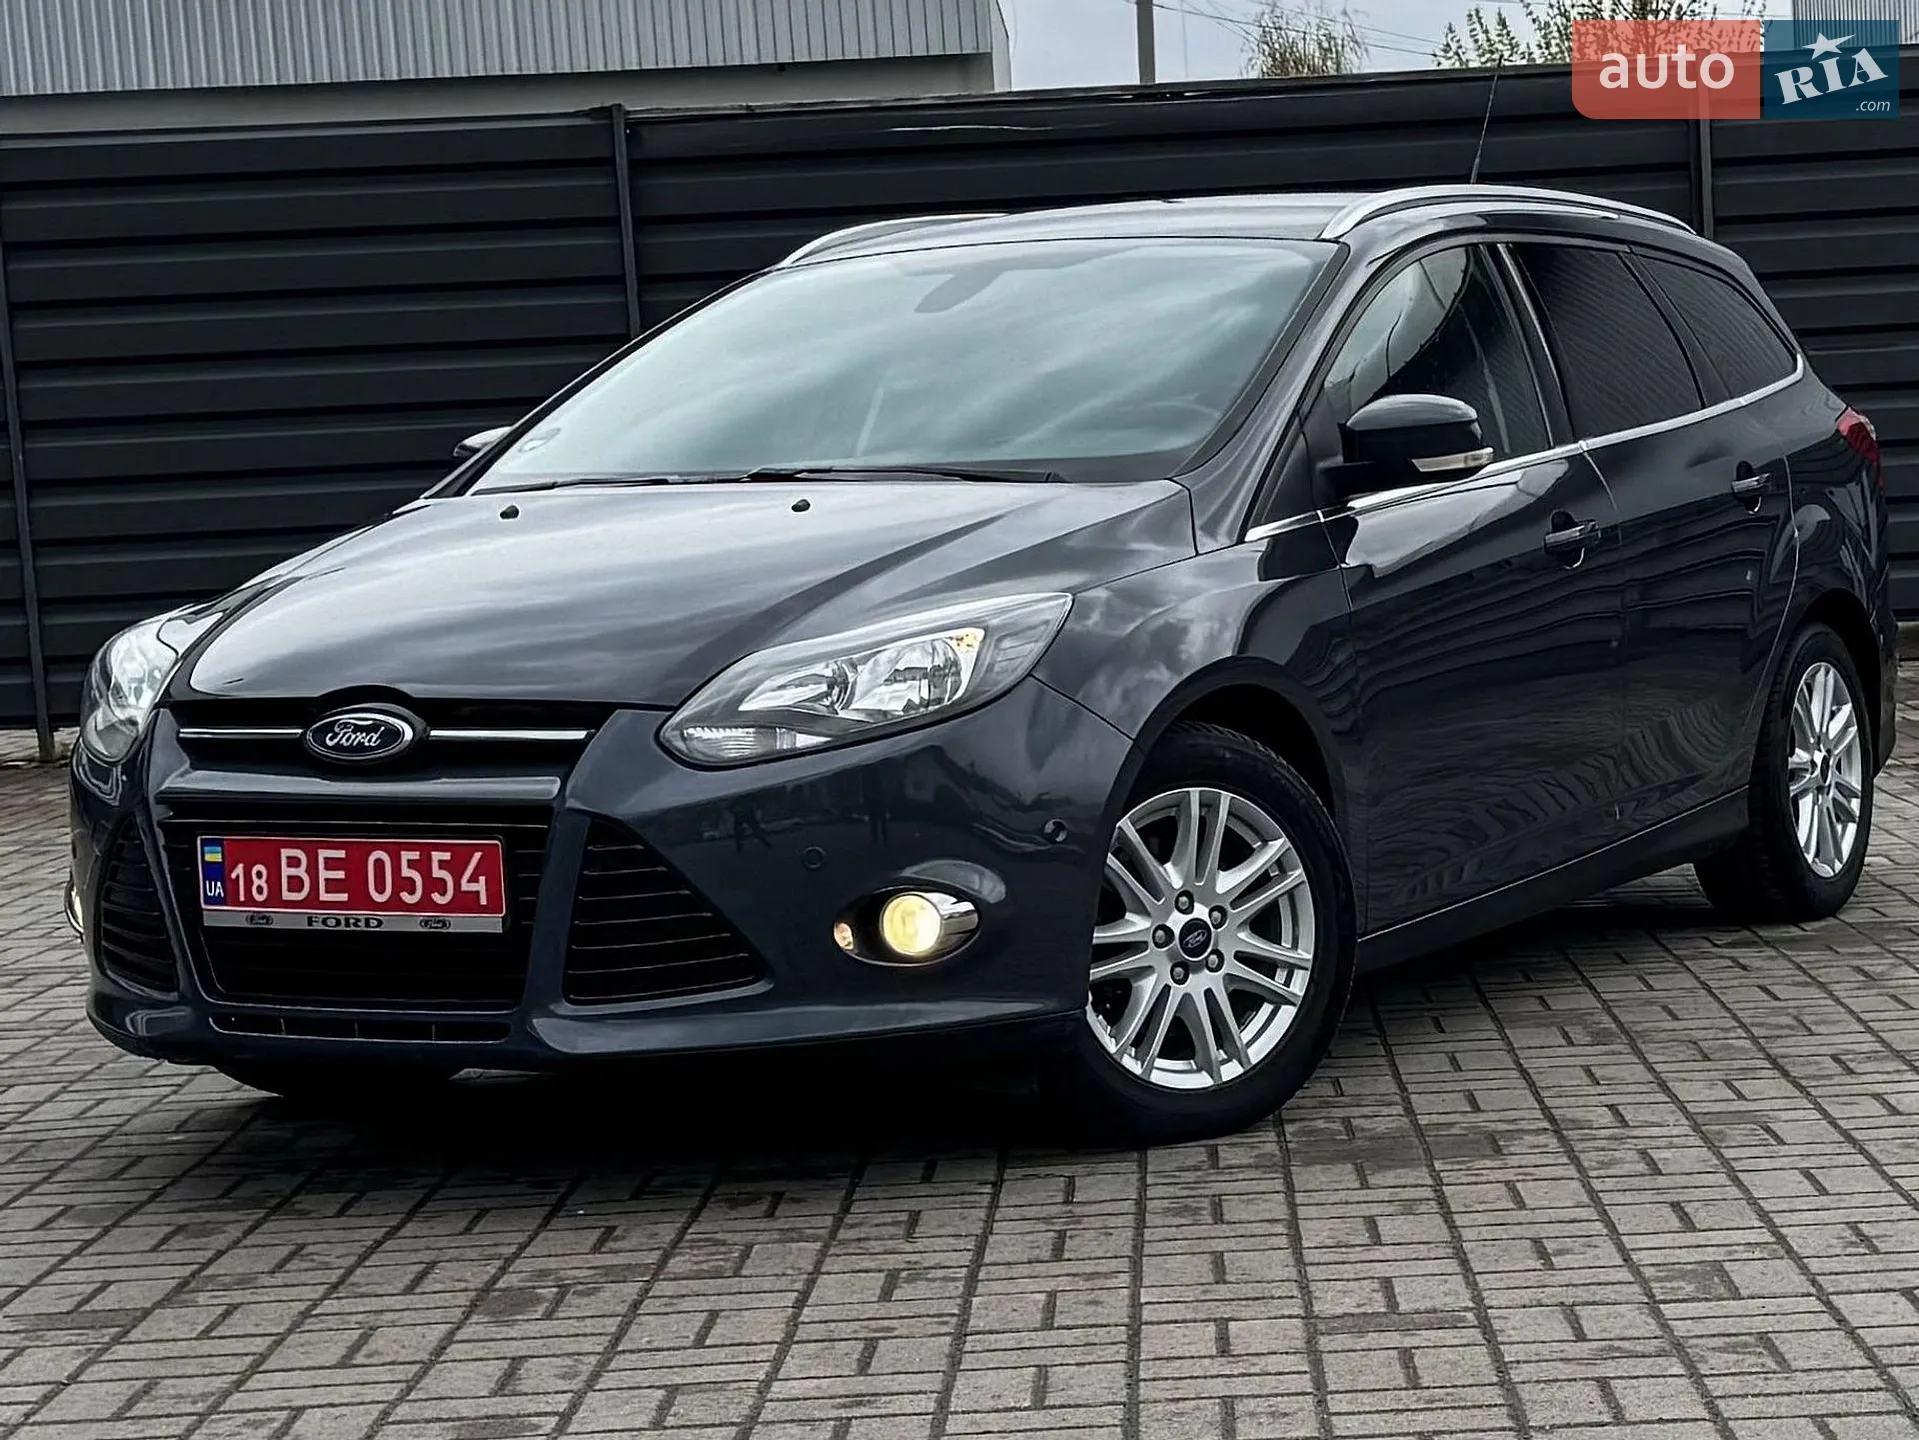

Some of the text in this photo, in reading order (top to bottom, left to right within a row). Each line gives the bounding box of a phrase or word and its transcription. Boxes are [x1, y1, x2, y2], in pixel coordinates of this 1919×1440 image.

[325, 719, 386, 747] Ford
[230, 848, 488, 906] 18 BE 0554
[205, 880, 225, 898] UA
[306, 915, 385, 930] FORD
